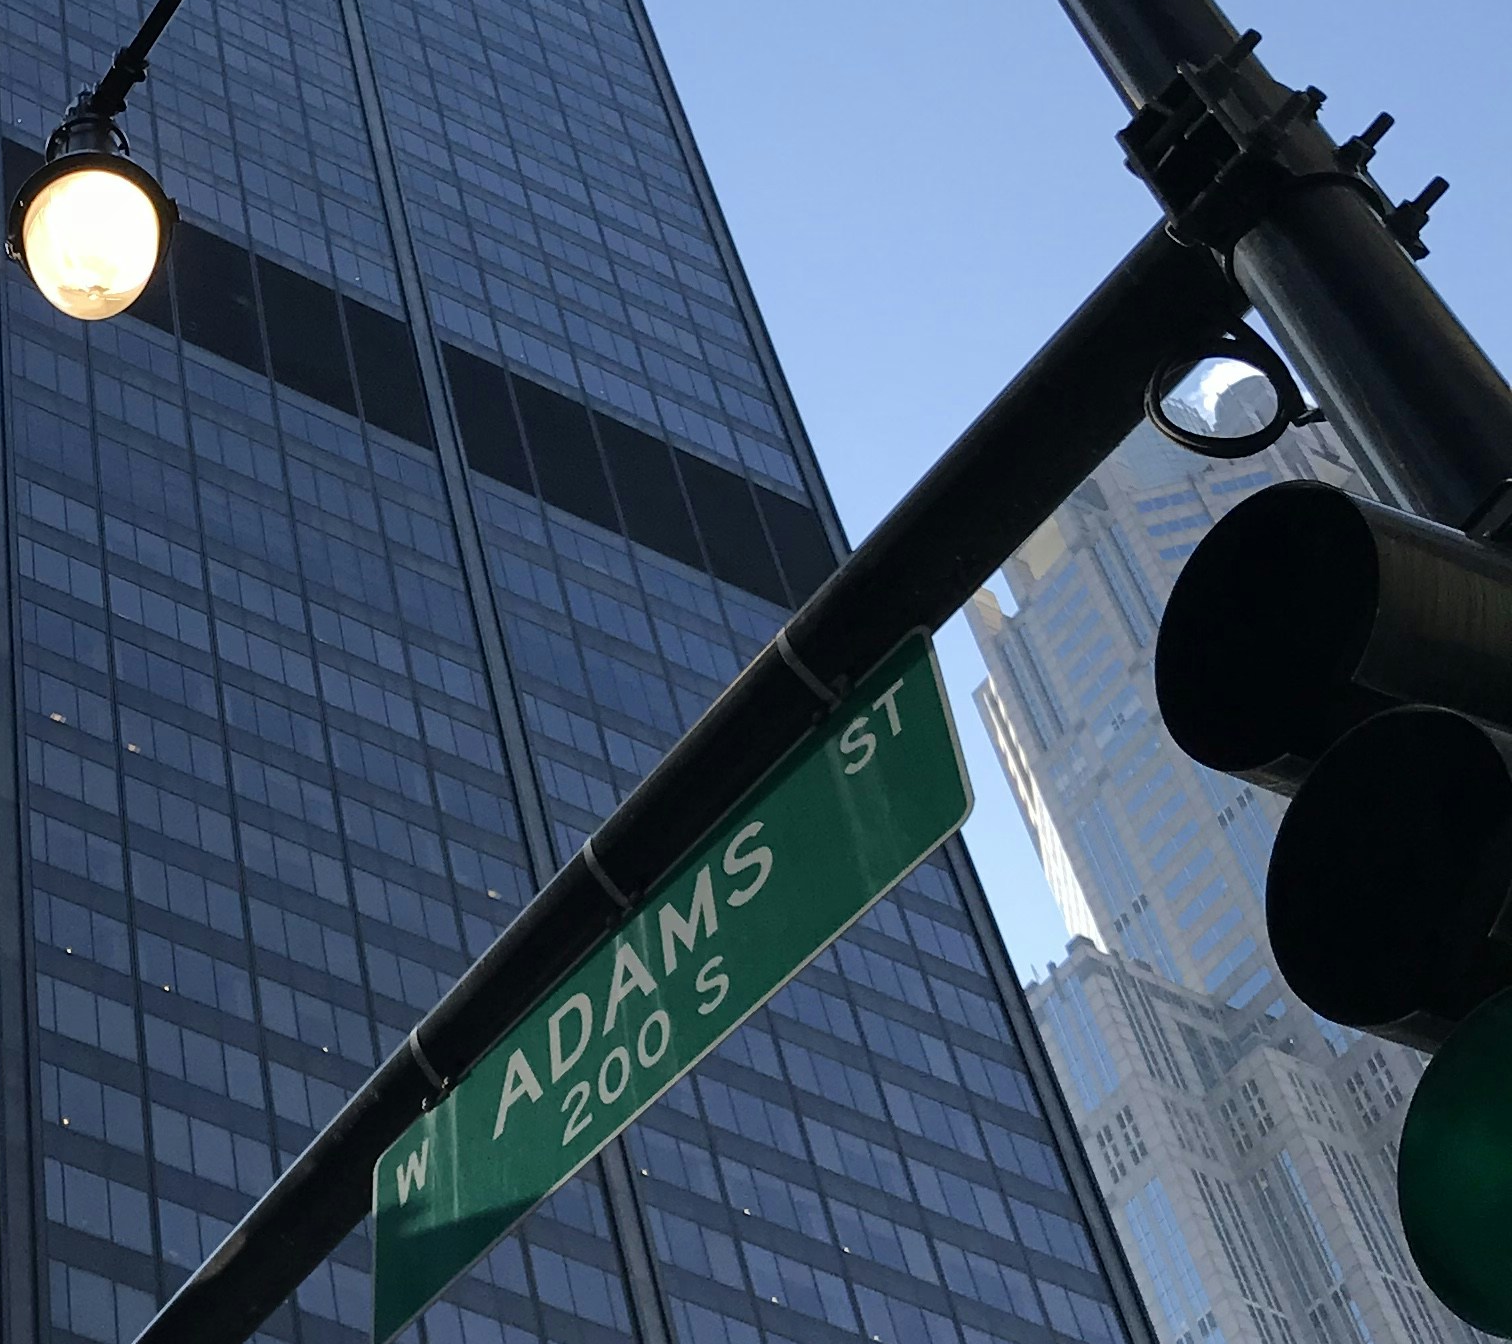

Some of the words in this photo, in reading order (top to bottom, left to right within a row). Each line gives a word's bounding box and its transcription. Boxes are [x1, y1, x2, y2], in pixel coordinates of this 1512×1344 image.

[396, 1138, 430, 1208] W
[492, 821, 774, 1141] ADAMS
[839, 679, 906, 775] ST
[560, 1010, 671, 1147] 200
[695, 956, 730, 1015] S
